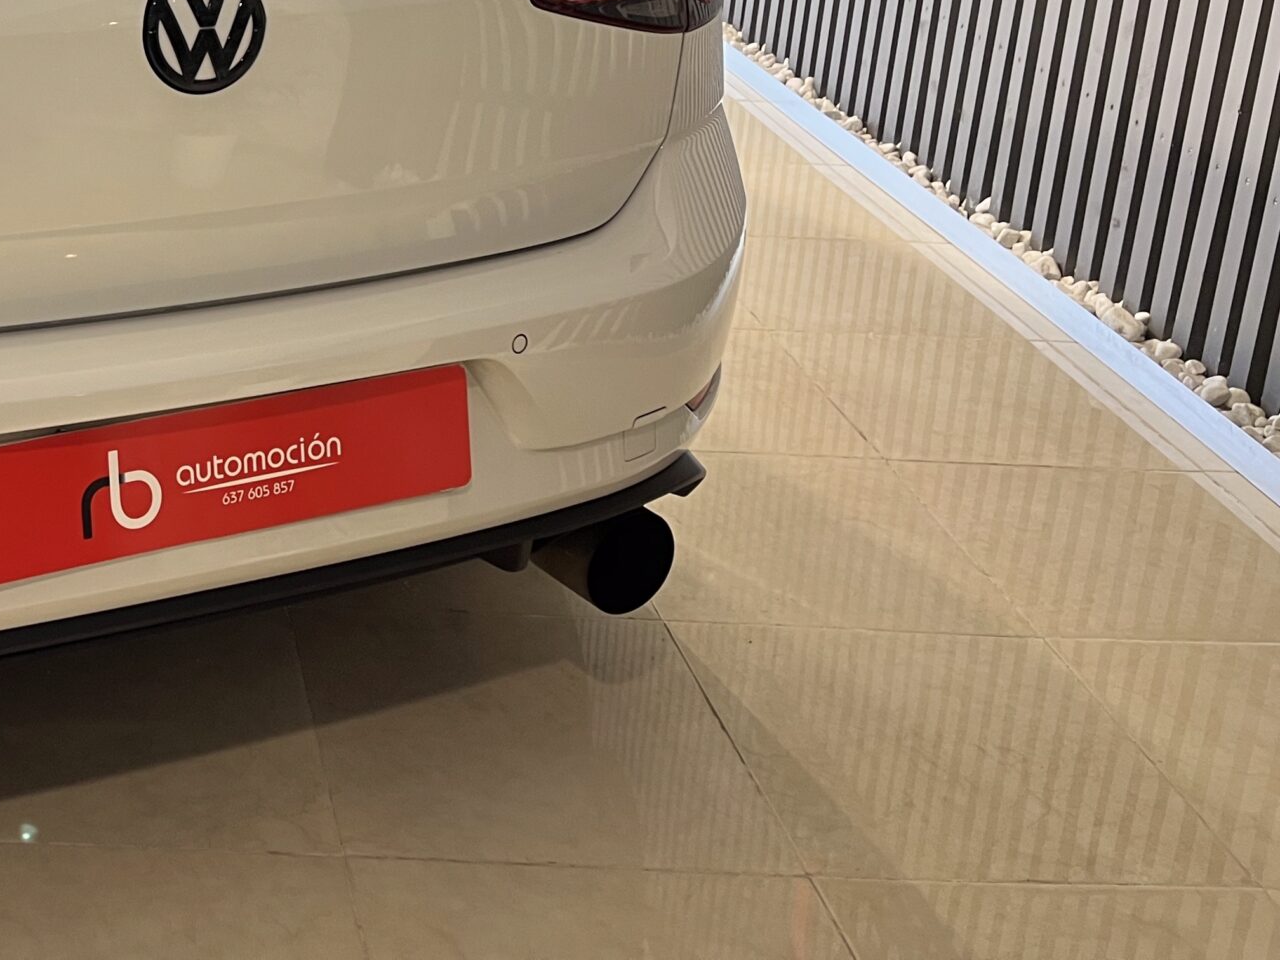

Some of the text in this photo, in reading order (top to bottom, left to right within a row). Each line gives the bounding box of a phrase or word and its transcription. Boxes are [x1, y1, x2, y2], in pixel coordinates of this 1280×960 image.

[175, 431, 342, 487] automoción
[80, 449, 163, 540] rb
[221, 479, 296, 506] 637 605 857
